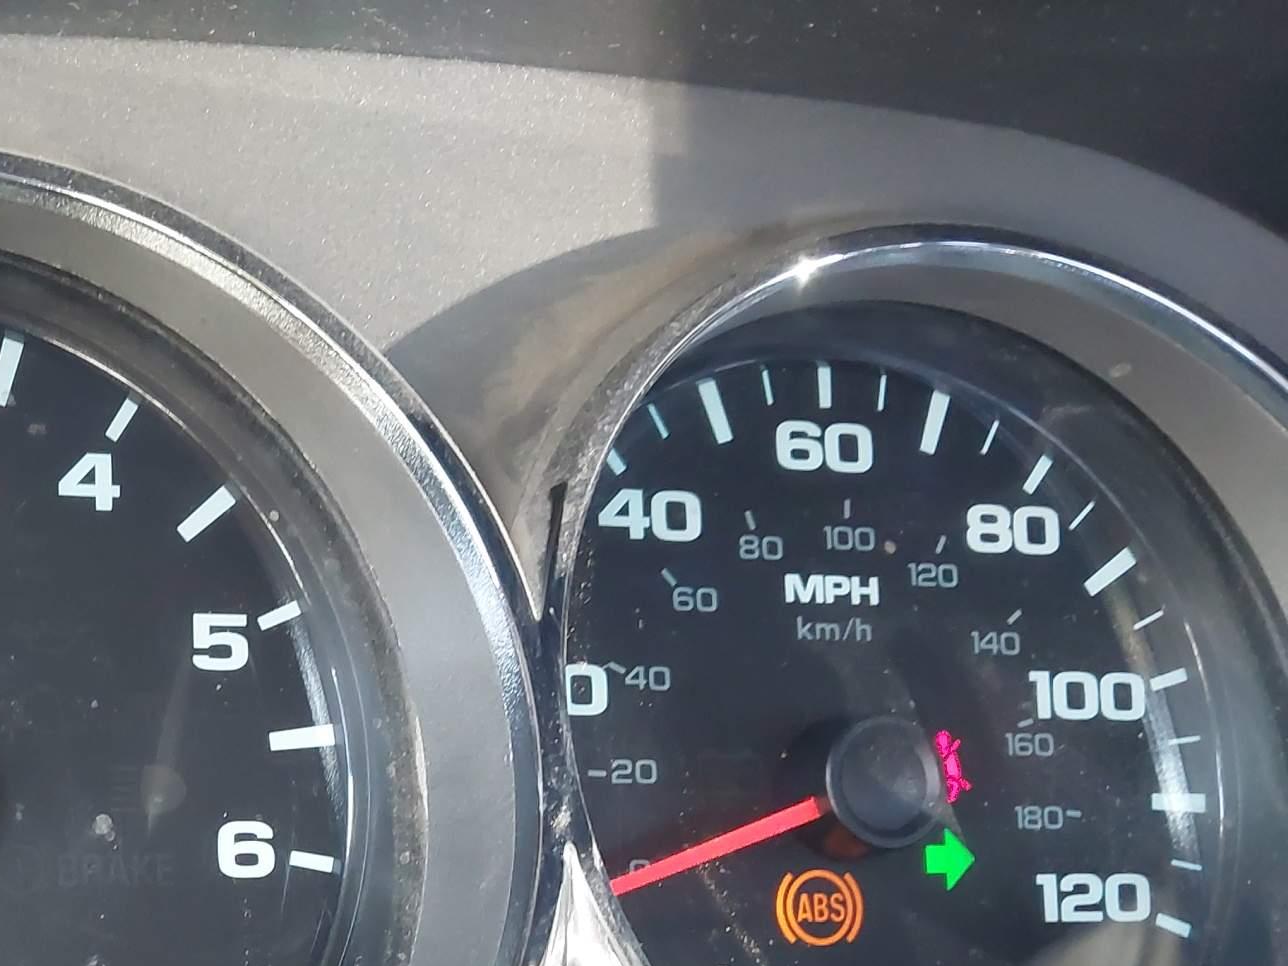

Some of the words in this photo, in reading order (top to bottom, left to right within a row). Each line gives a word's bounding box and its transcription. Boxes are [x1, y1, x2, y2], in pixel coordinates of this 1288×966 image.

[775, 420, 874, 474] 60
[58, 452, 121, 511] 4
[598, 488, 703, 542] 40
[966, 504, 1060, 555] 80
[738, 535, 784, 561] 80
[823, 525, 875, 552] 100
[784, 573, 880, 606] MPH
[908, 562, 959, 588] 120
[672, 587, 718, 613] 60
[192, 612, 249, 671] 5
[796, 616, 872, 642] km/h
[971, 630, 1021, 656] 140
[565, 663, 608, 716] 0
[624, 665, 671, 691] 40
[1029, 670, 1145, 721] 100
[1006, 733, 1055, 758] 160
[612, 759, 658, 785] 20
[1014, 806, 1063, 830] 180
[216, 820, 276, 879] 6
[797, 893, 846, 923] ABS
[1036, 873, 1150, 923] 120
